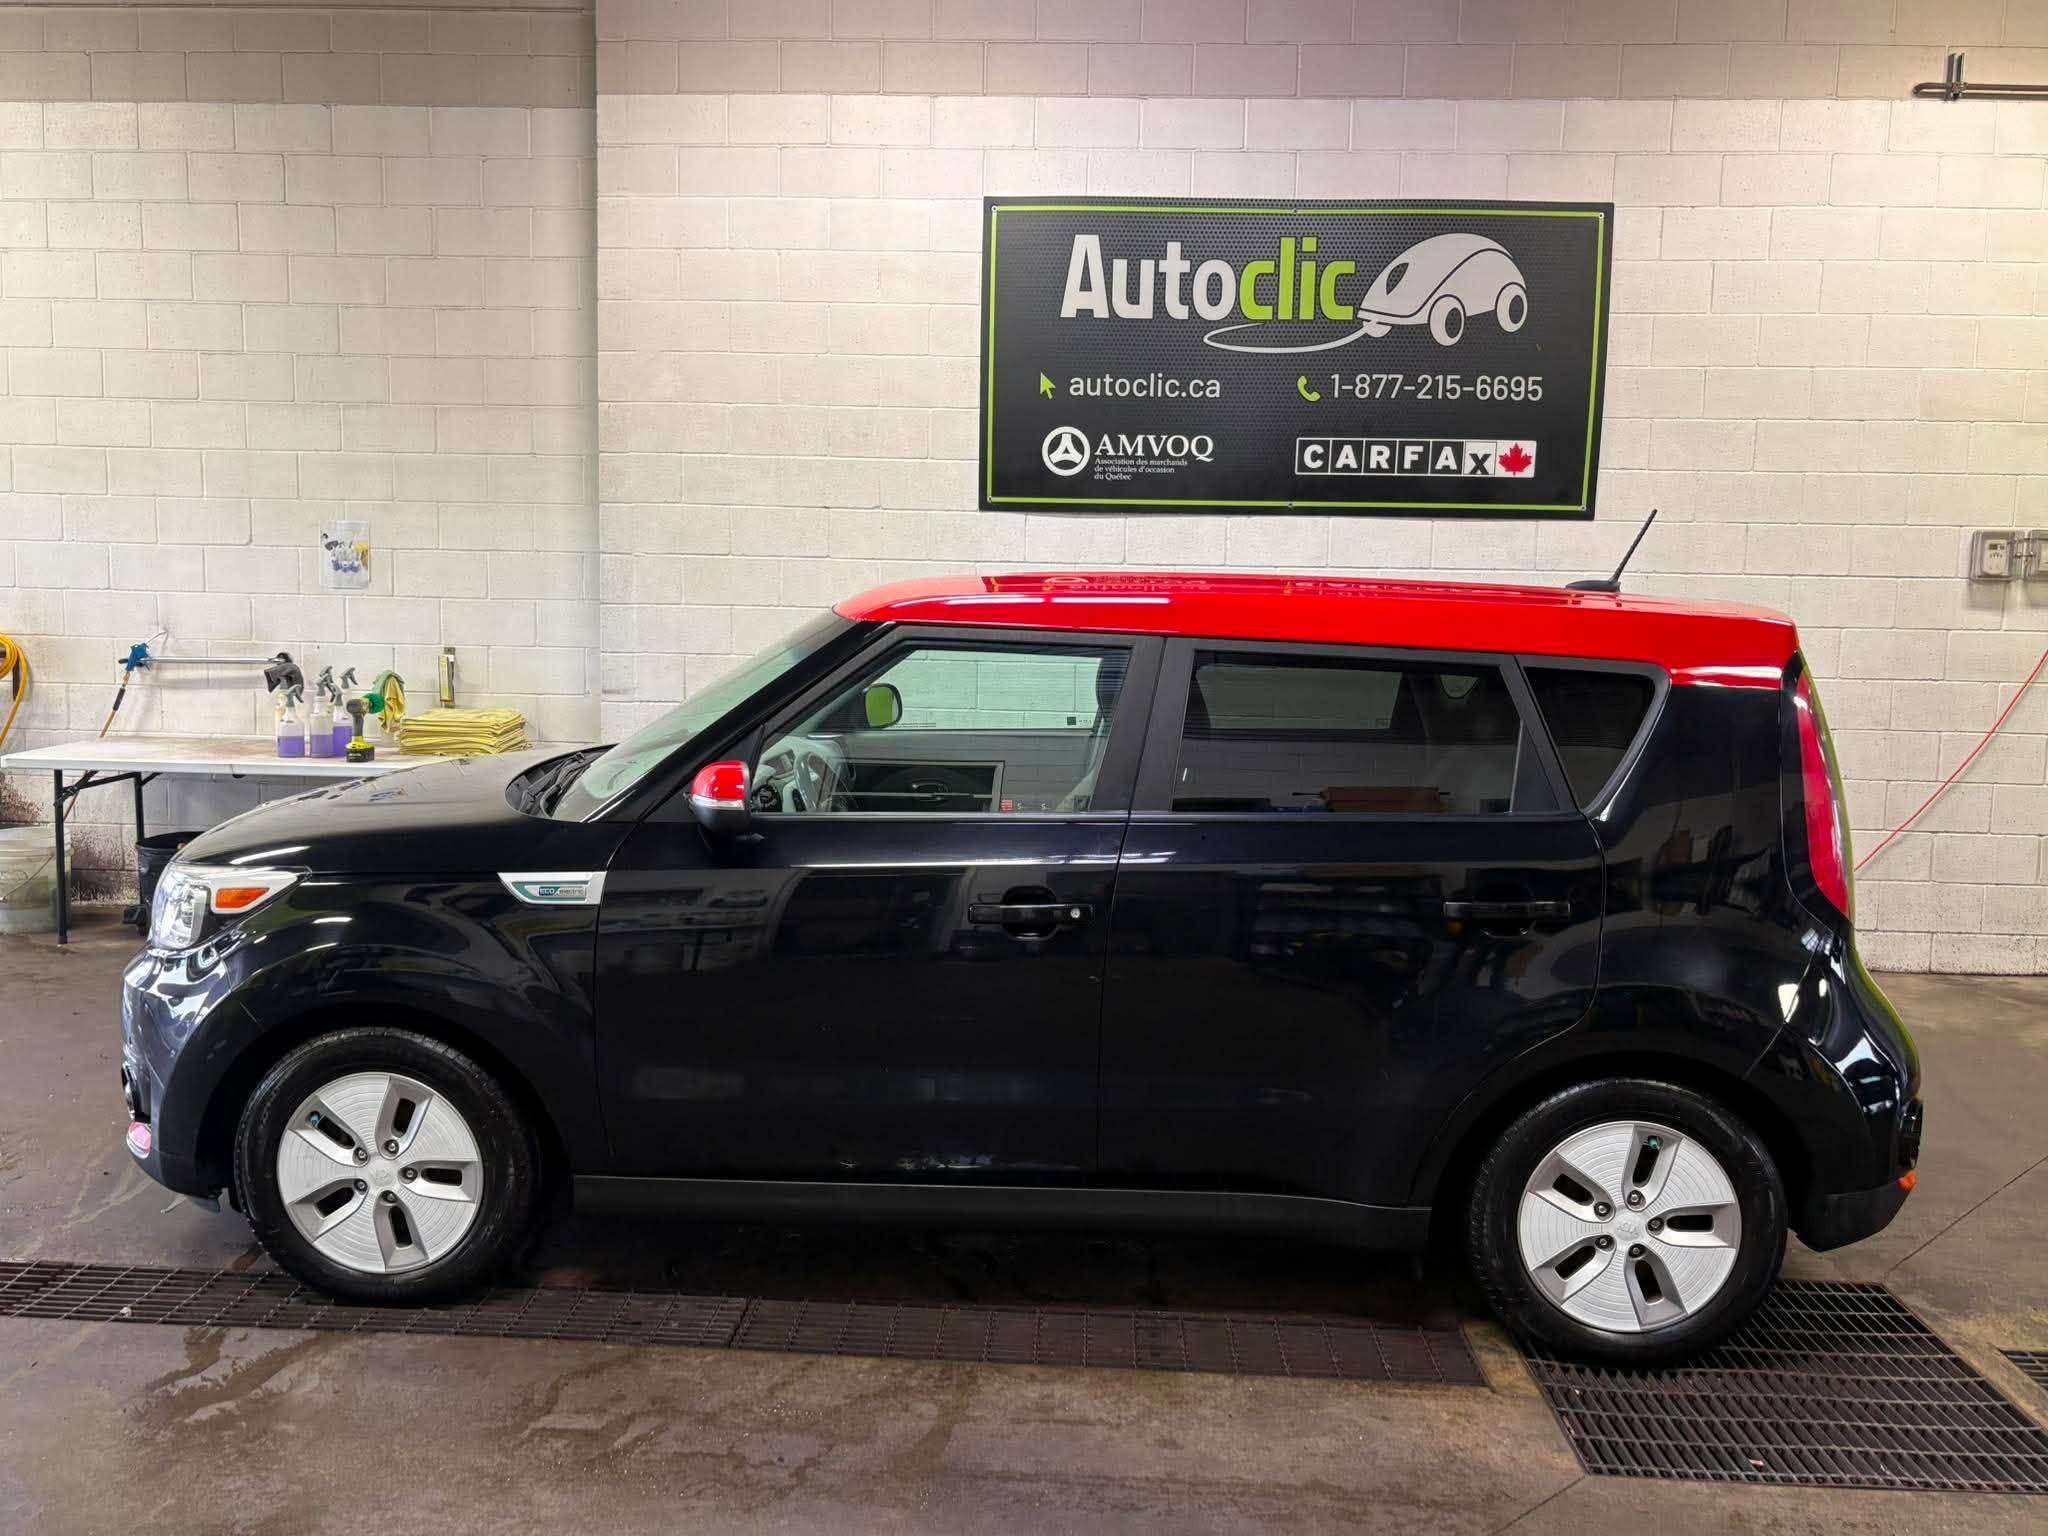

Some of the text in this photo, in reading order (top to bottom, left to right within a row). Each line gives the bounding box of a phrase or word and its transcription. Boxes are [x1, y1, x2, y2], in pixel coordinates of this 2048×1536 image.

[1060, 233, 1356, 321] Autoclic
[1069, 373, 1221, 398] autoclic.ca
[1330, 373, 1543, 401] 1-877-215-6695
[1094, 433, 1215, 462] AMVOQ
[1303, 444, 1492, 475] CARFAX
[1094, 457, 1188, 467] Association des marchands
[1094, 465, 1104, 473] de
[1104, 466, 1137, 474] véhicules
[1105, 472, 1133, 481] Québec
